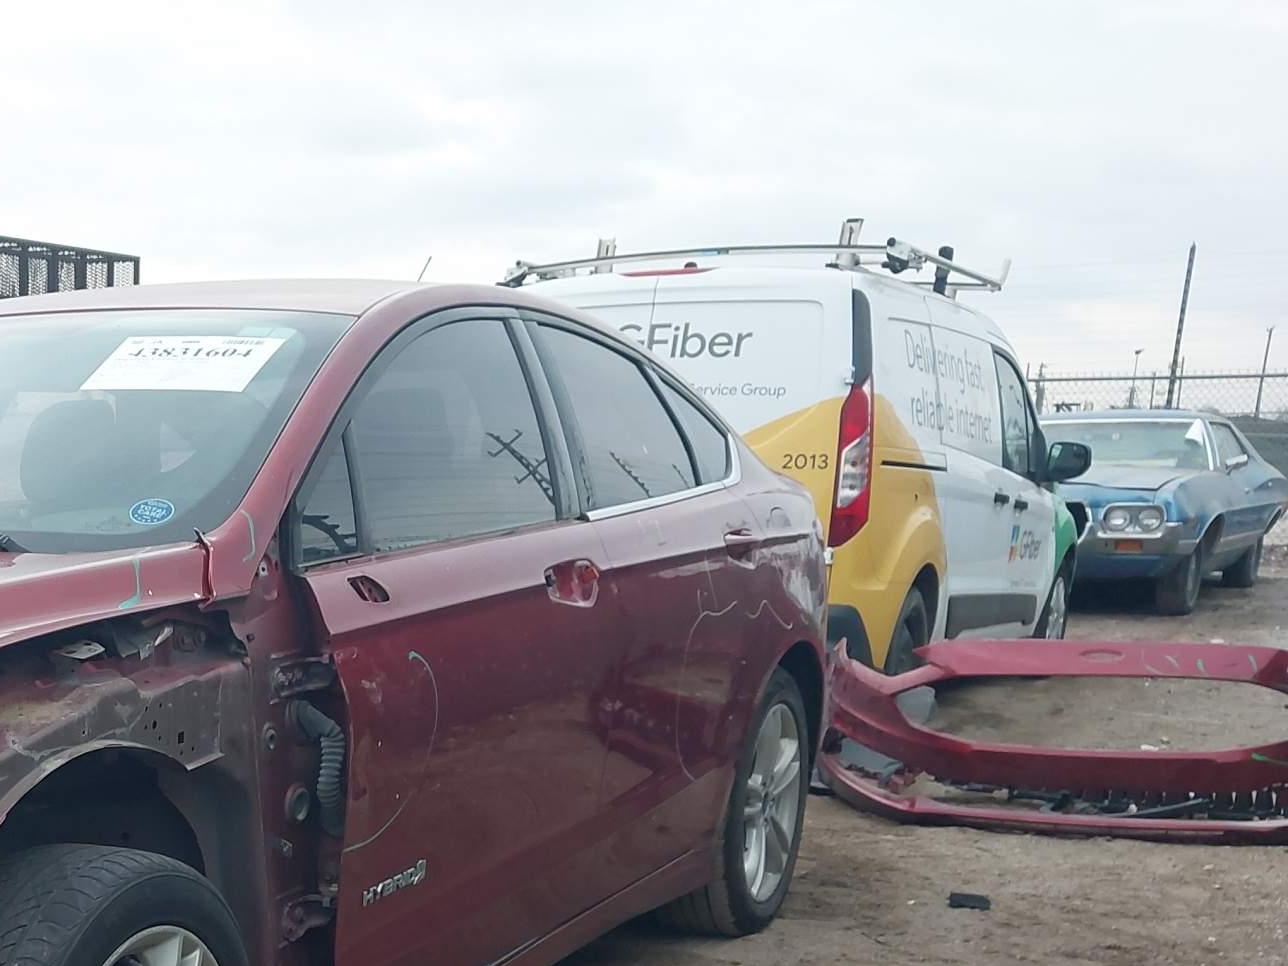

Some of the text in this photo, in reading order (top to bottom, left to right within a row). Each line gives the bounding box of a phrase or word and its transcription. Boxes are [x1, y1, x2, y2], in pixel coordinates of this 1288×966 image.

[128, 347, 254, 358] 43831604
[690, 382, 787, 400] ervice Group
[781, 453, 829, 470] 2013
[362, 866, 416, 907] HYBRID
